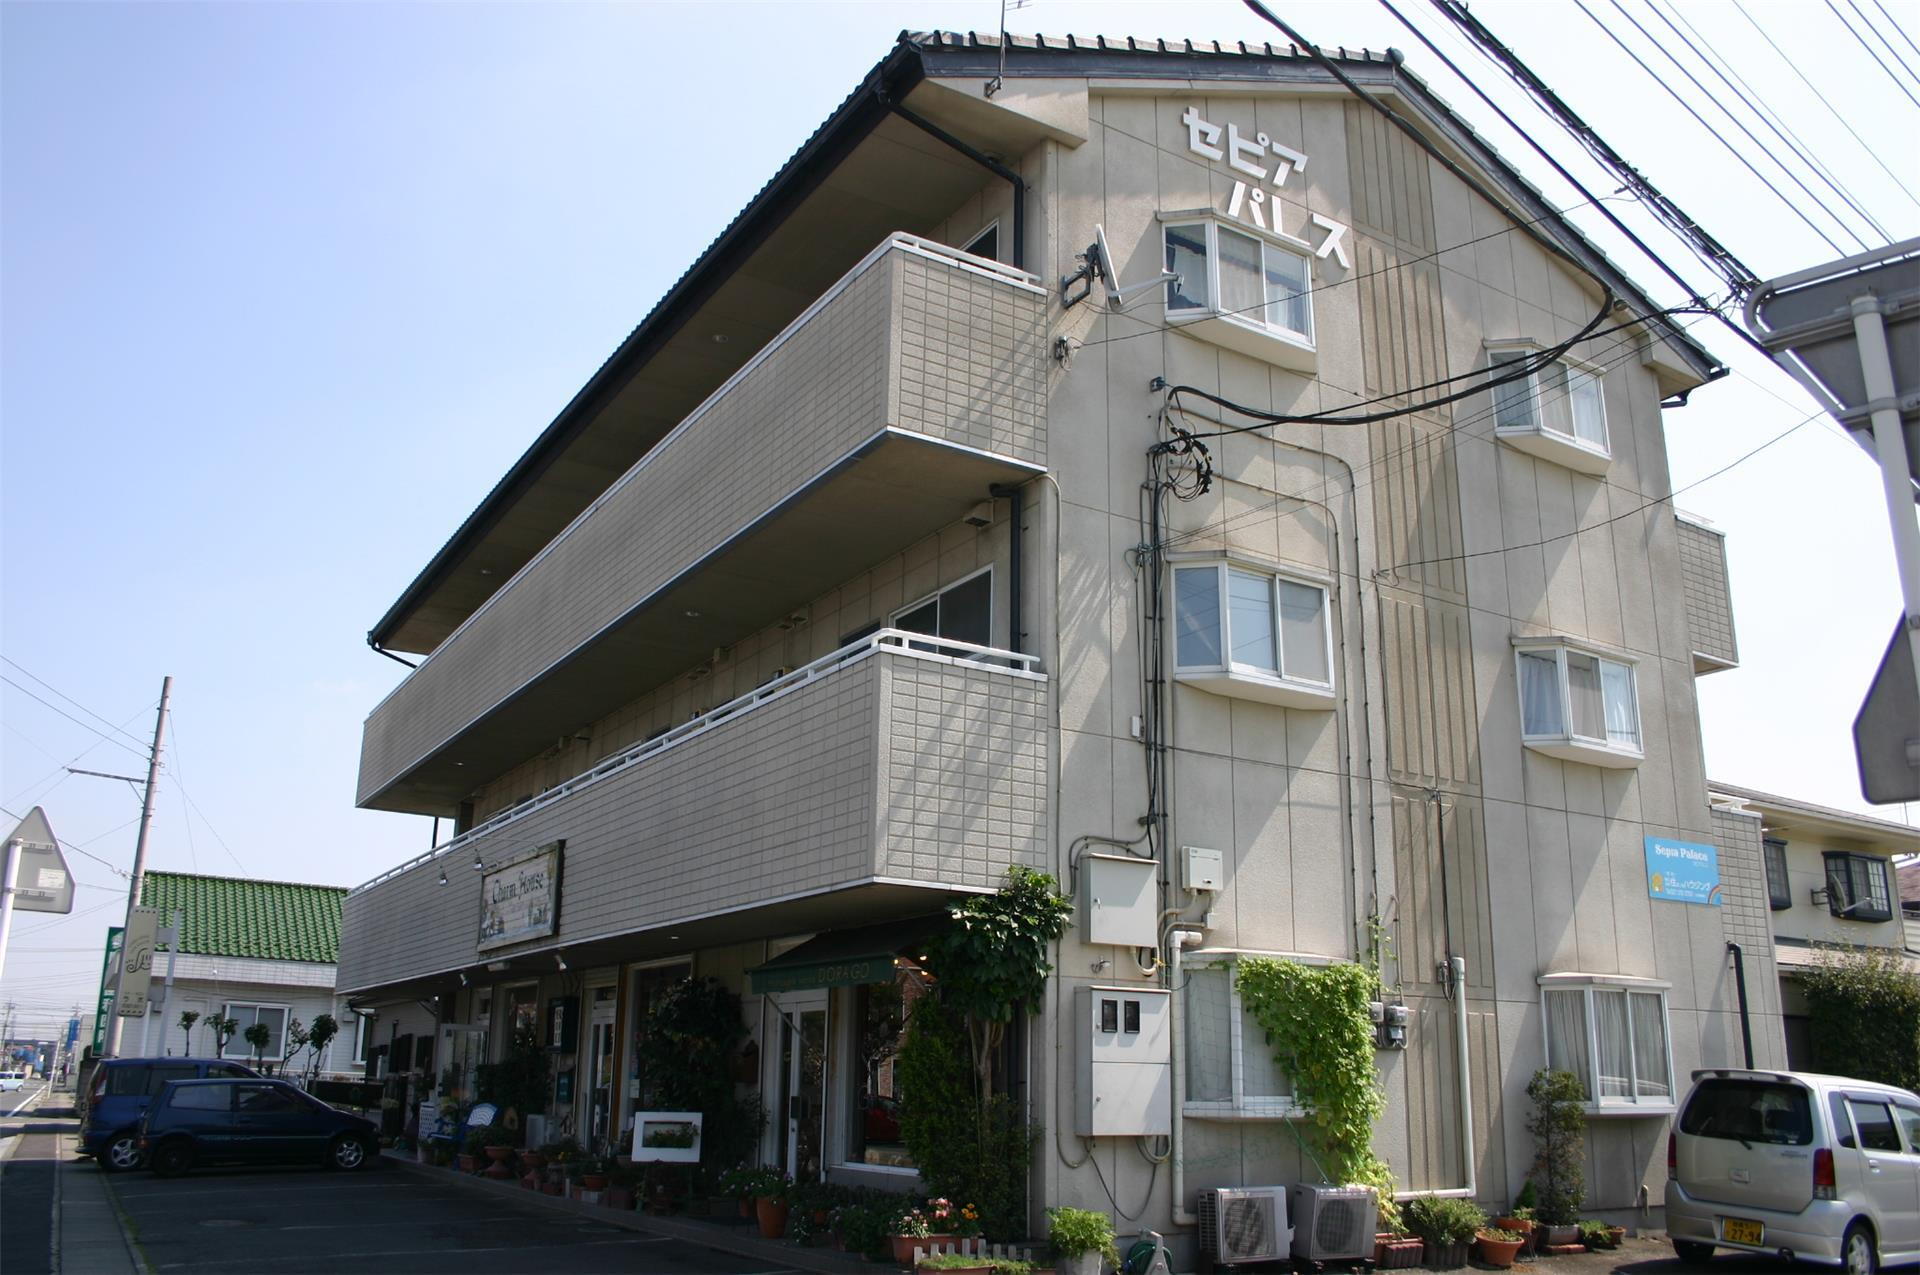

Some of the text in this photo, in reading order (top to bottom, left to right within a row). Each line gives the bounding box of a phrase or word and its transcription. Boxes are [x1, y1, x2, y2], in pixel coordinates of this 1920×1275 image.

[1182, 106, 1309, 187] セピア
[1228, 181, 1351, 270] パレス
